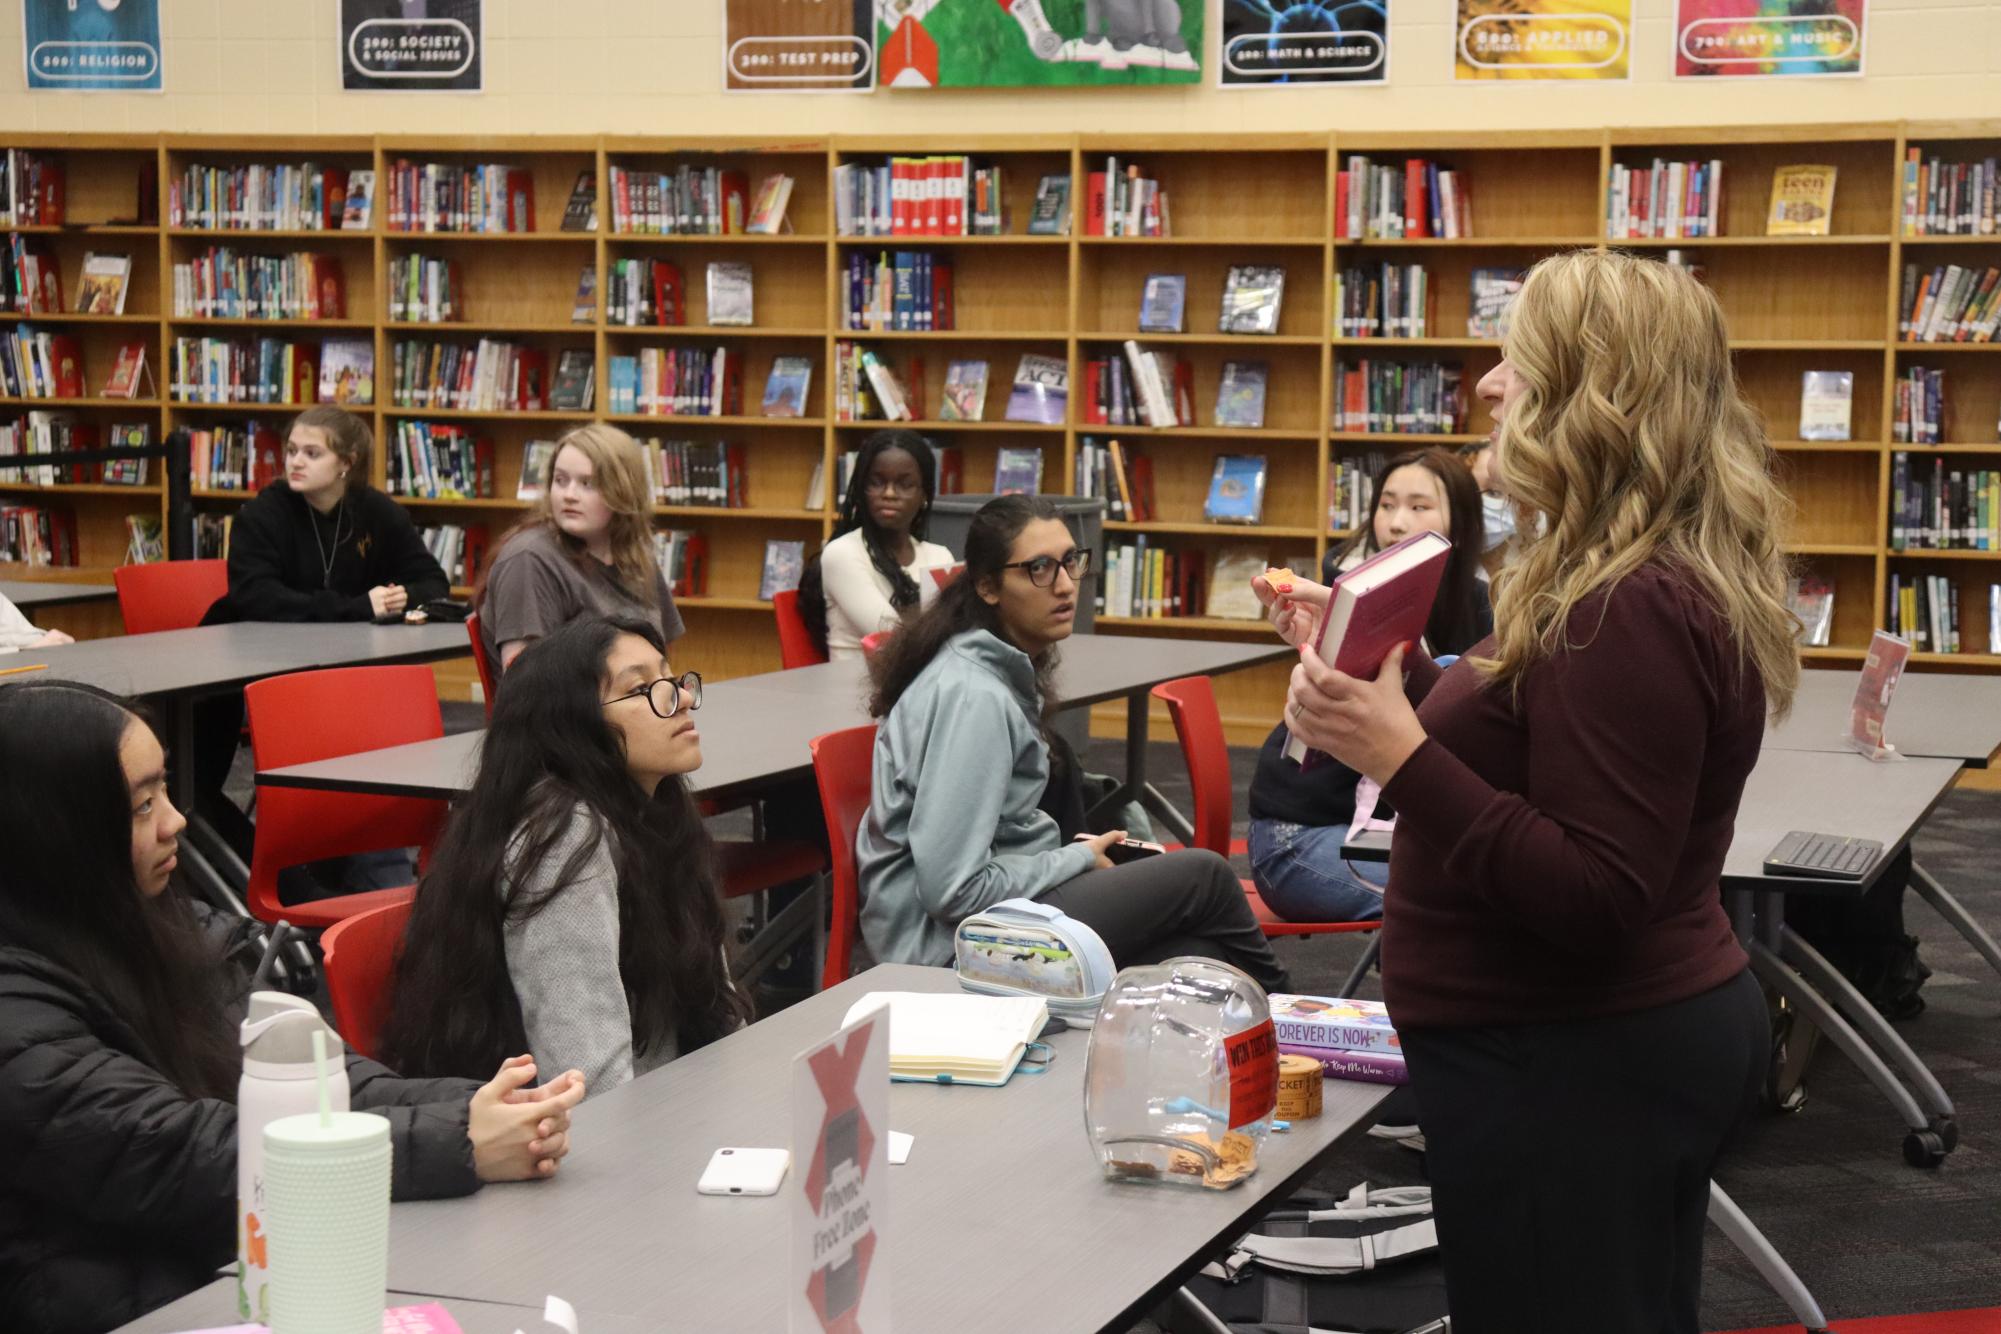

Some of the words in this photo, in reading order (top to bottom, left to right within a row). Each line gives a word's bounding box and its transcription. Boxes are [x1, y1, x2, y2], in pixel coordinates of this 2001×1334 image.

[399, 35, 461, 49] SOCIETY
[1523, 30, 1609, 44] APPLIED
[1737, 34, 1768, 46] ART
[1790, 32, 1842, 45] MUSIC
[374, 50, 418, 60] SOCIAL
[420, 50, 461, 60] ISSUES
[779, 52, 817, 64] TEST
[821, 52, 860, 64] PREP
[1267, 48, 1302, 59] MATH
[1318, 46, 1372, 58] SCIENCE
[79, 54, 147, 67] RELIGION
[1019, 368, 1066, 387] ACT
[1274, 1022, 1325, 1043] OREVER
[1329, 1027, 1340, 1044] IS
[1343, 1029, 1370, 1048] NOW
[1330, 1060, 1347, 1074] Keep
[1279, 1079, 1304, 1090] CKET
[824, 1175, 861, 1220] Phone
[813, 1221, 839, 1261] Free
[842, 1200, 871, 1239] Zone
